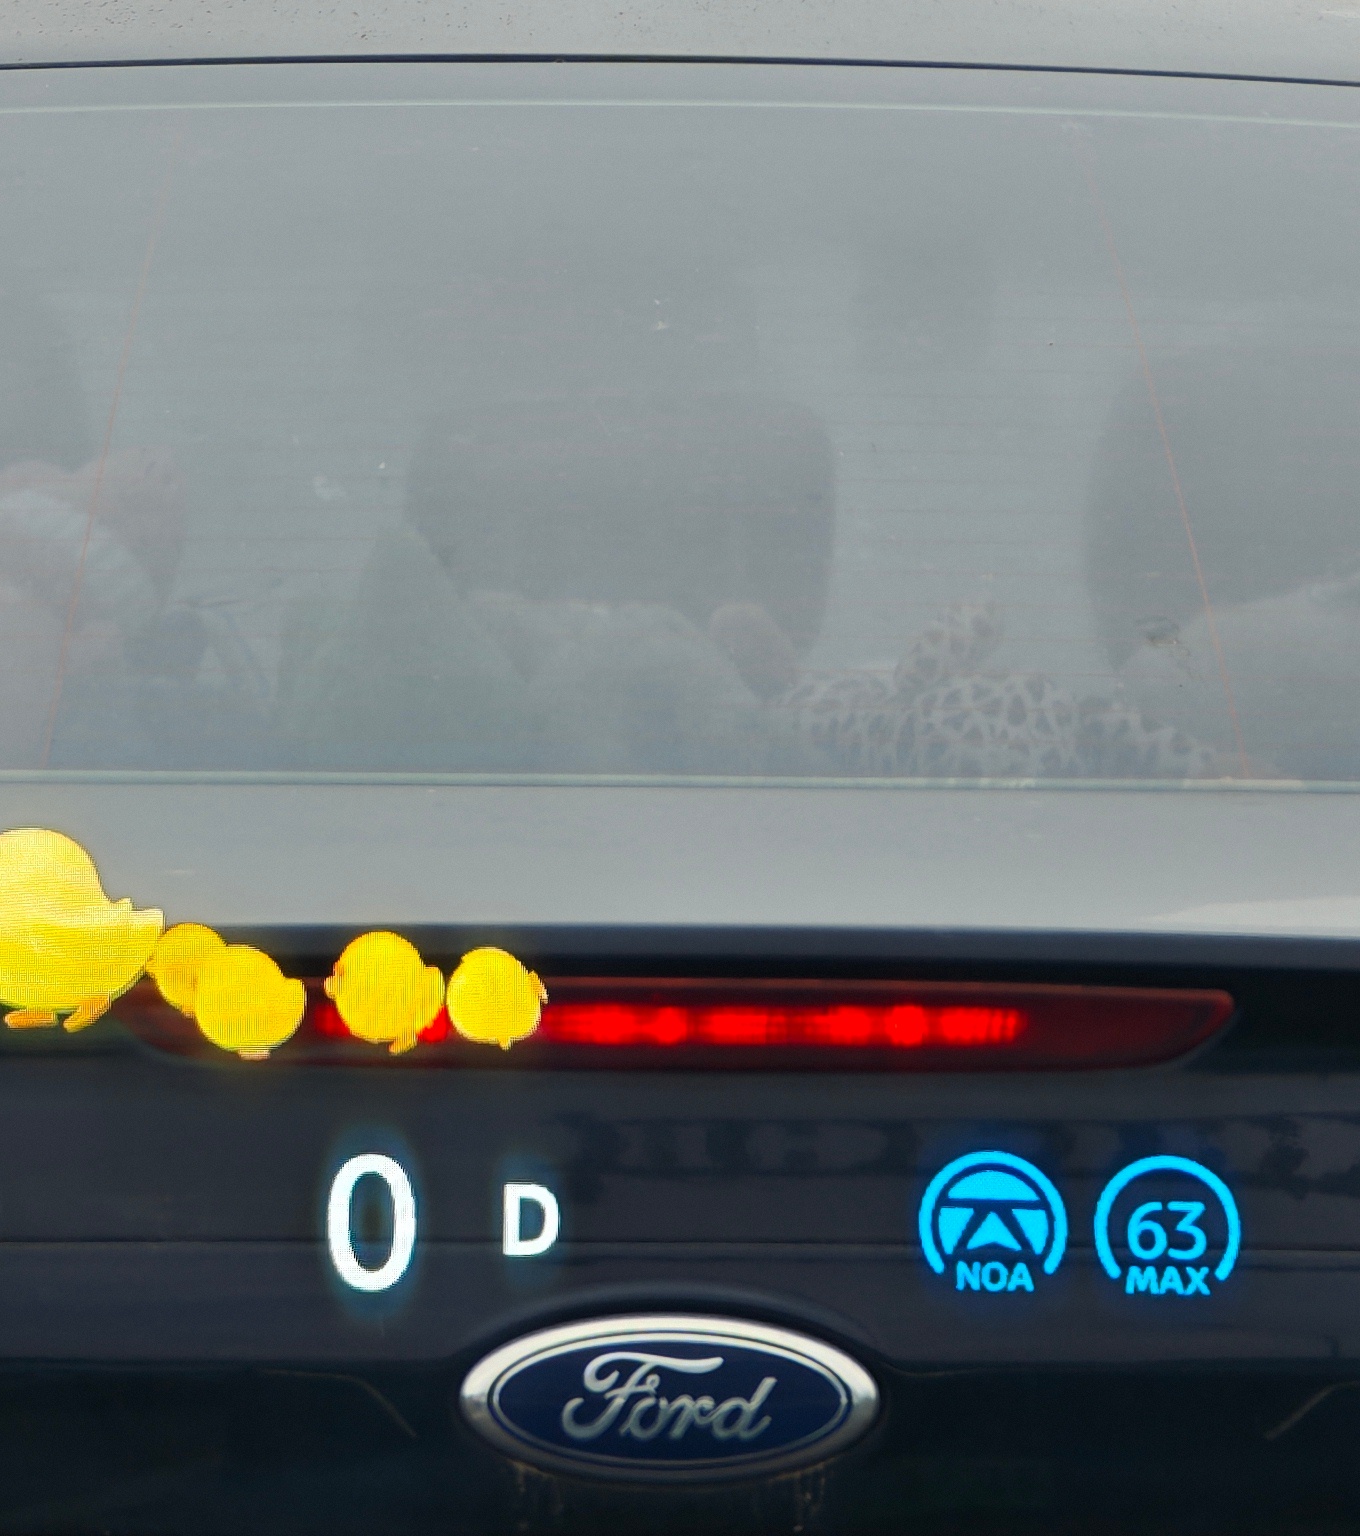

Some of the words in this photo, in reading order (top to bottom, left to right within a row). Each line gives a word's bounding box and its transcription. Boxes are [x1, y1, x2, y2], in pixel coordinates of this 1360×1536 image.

[328, 1154, 416, 1292] 0
[502, 1182, 561, 1257] D
[1127, 1201, 1207, 1260] 63
[955, 1260, 1035, 1293] NOA
[1125, 1265, 1211, 1296] MAX
[561, 1351, 778, 1440] Ford
